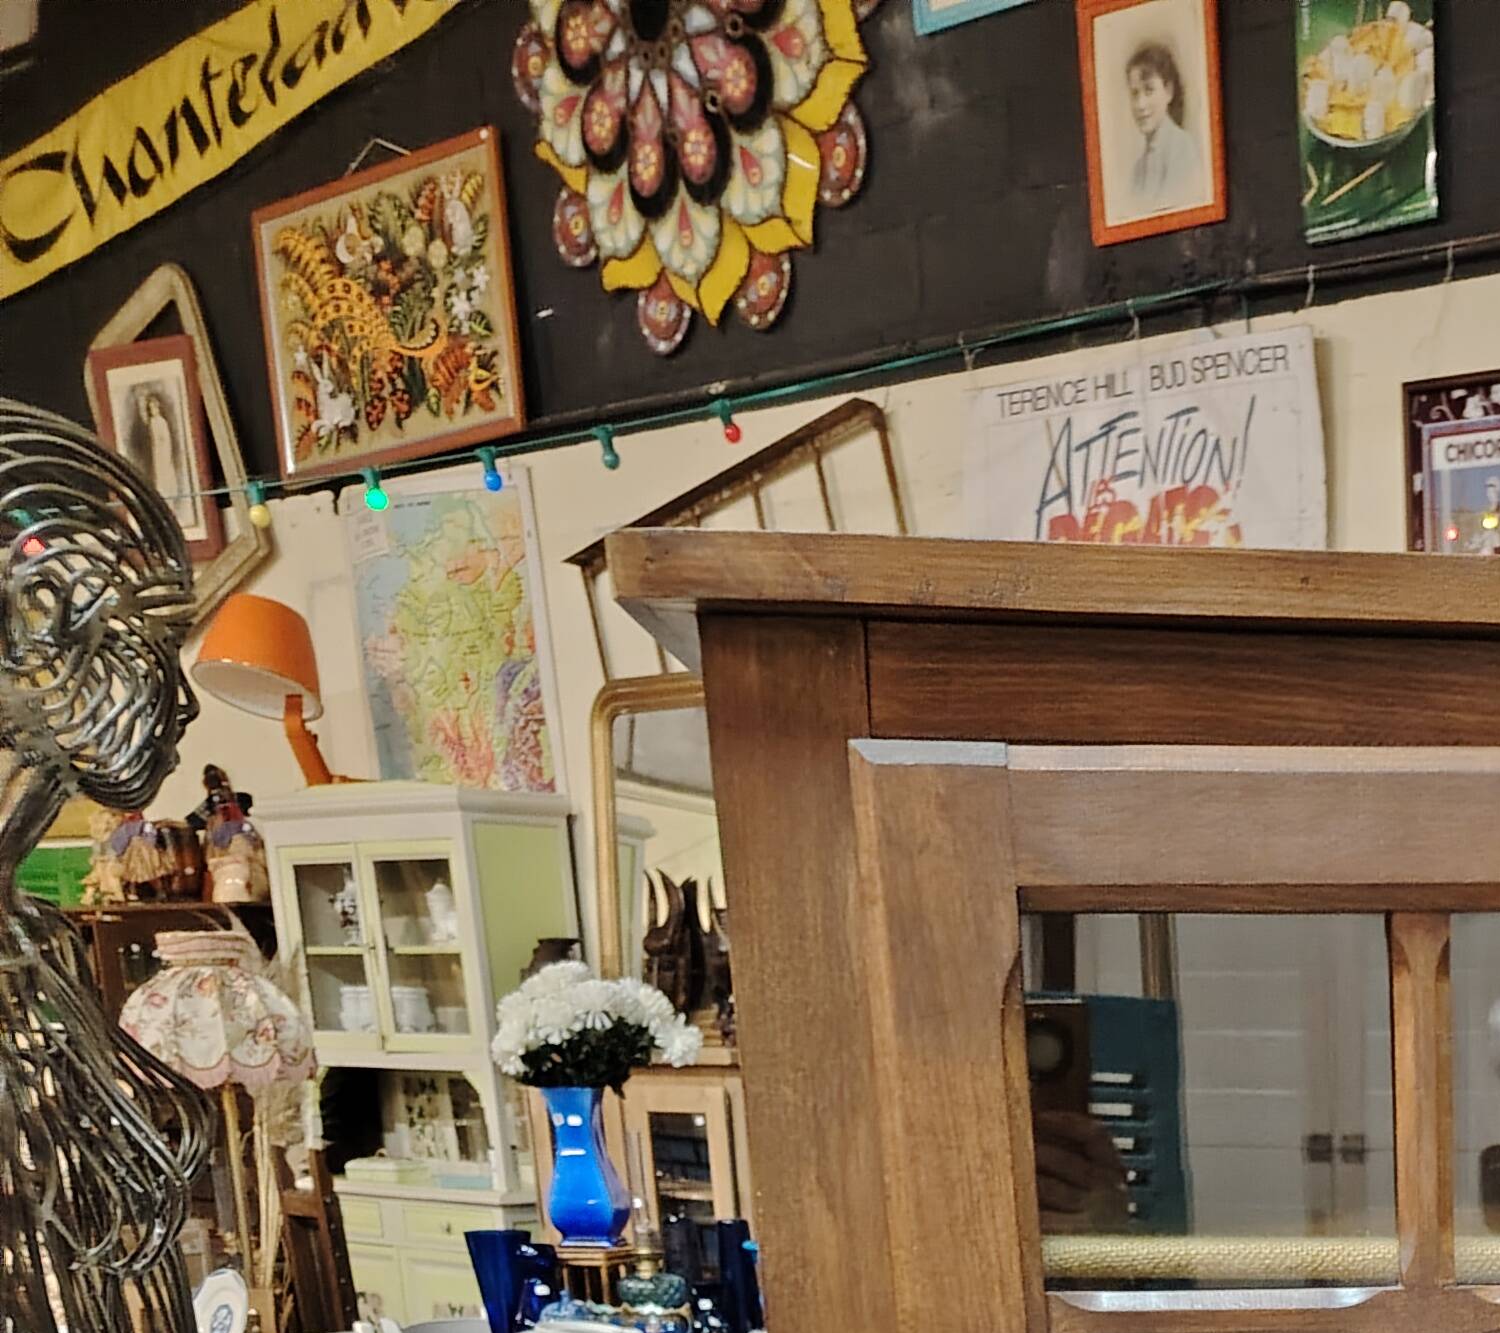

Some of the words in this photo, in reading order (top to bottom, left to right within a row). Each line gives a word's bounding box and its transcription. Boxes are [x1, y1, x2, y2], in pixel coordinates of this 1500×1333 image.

[997, 377, 1088, 418] TERENCE
[1092, 369, 1134, 401] HILL
[1150, 360, 1186, 391] BUD
[1191, 344, 1289, 384] SPENCER
